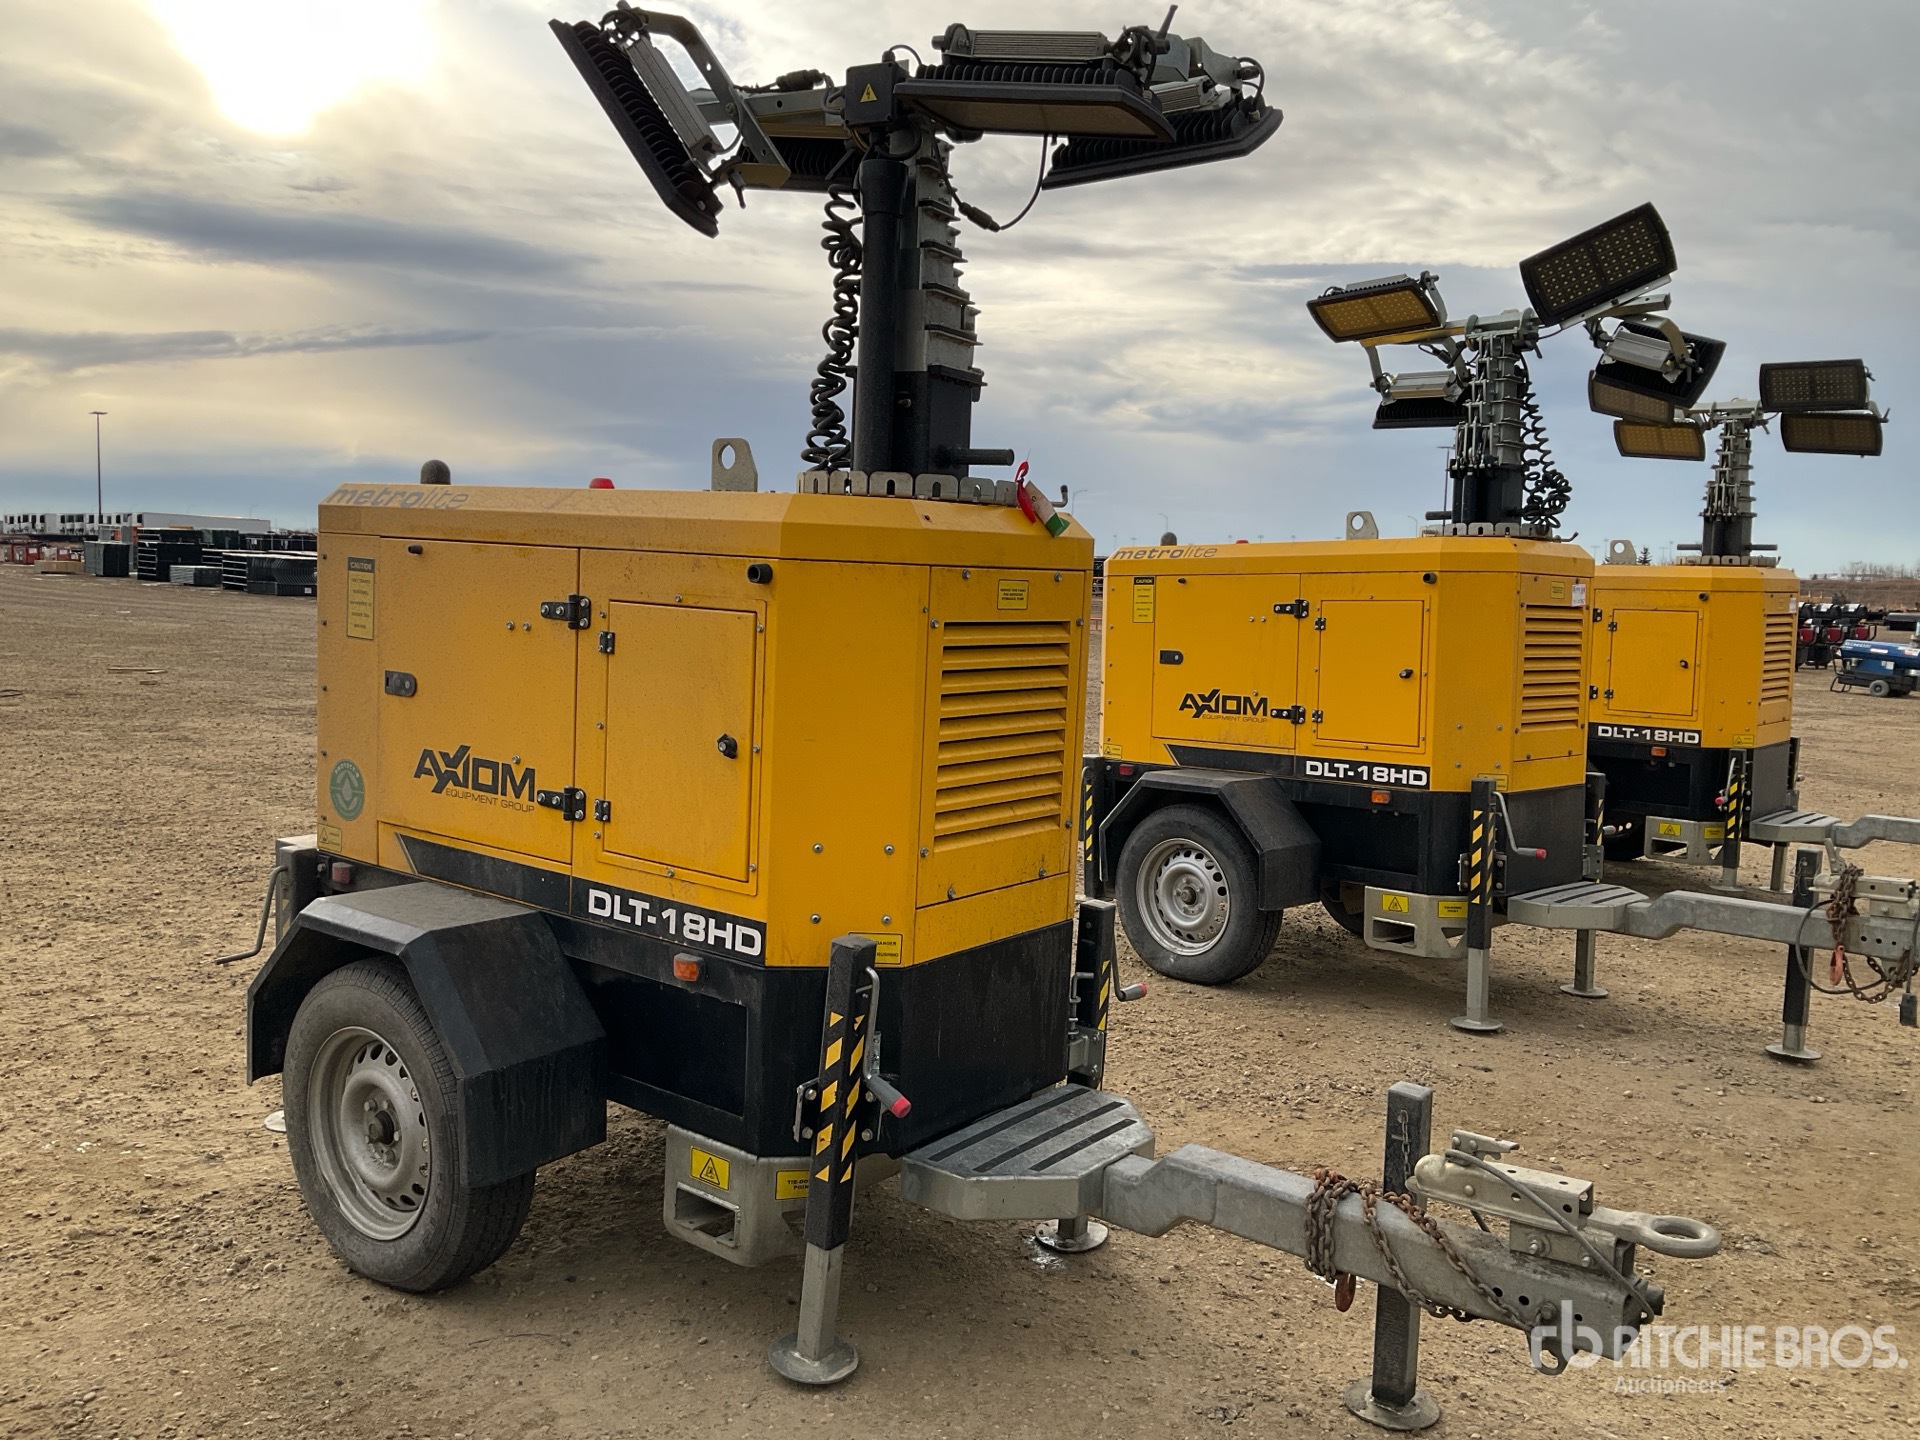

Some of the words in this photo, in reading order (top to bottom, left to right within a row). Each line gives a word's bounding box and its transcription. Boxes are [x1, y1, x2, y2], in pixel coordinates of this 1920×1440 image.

[326, 486, 470, 511] metrolite
[1112, 545, 1218, 560] metrolite
[1178, 688, 1268, 719] AXIOM
[1202, 713, 1241, 722] EQUIPMENT
[1242, 716, 1268, 724] GROUP
[1597, 725, 1700, 745] DLT-18HD
[413, 744, 536, 803] AXIOM
[1305, 760, 1428, 787] DLT-18HD
[445, 787, 498, 806] EQUIPMENT
[500, 799, 535, 813] GROUP
[588, 888, 762, 956] DLT-18HD
